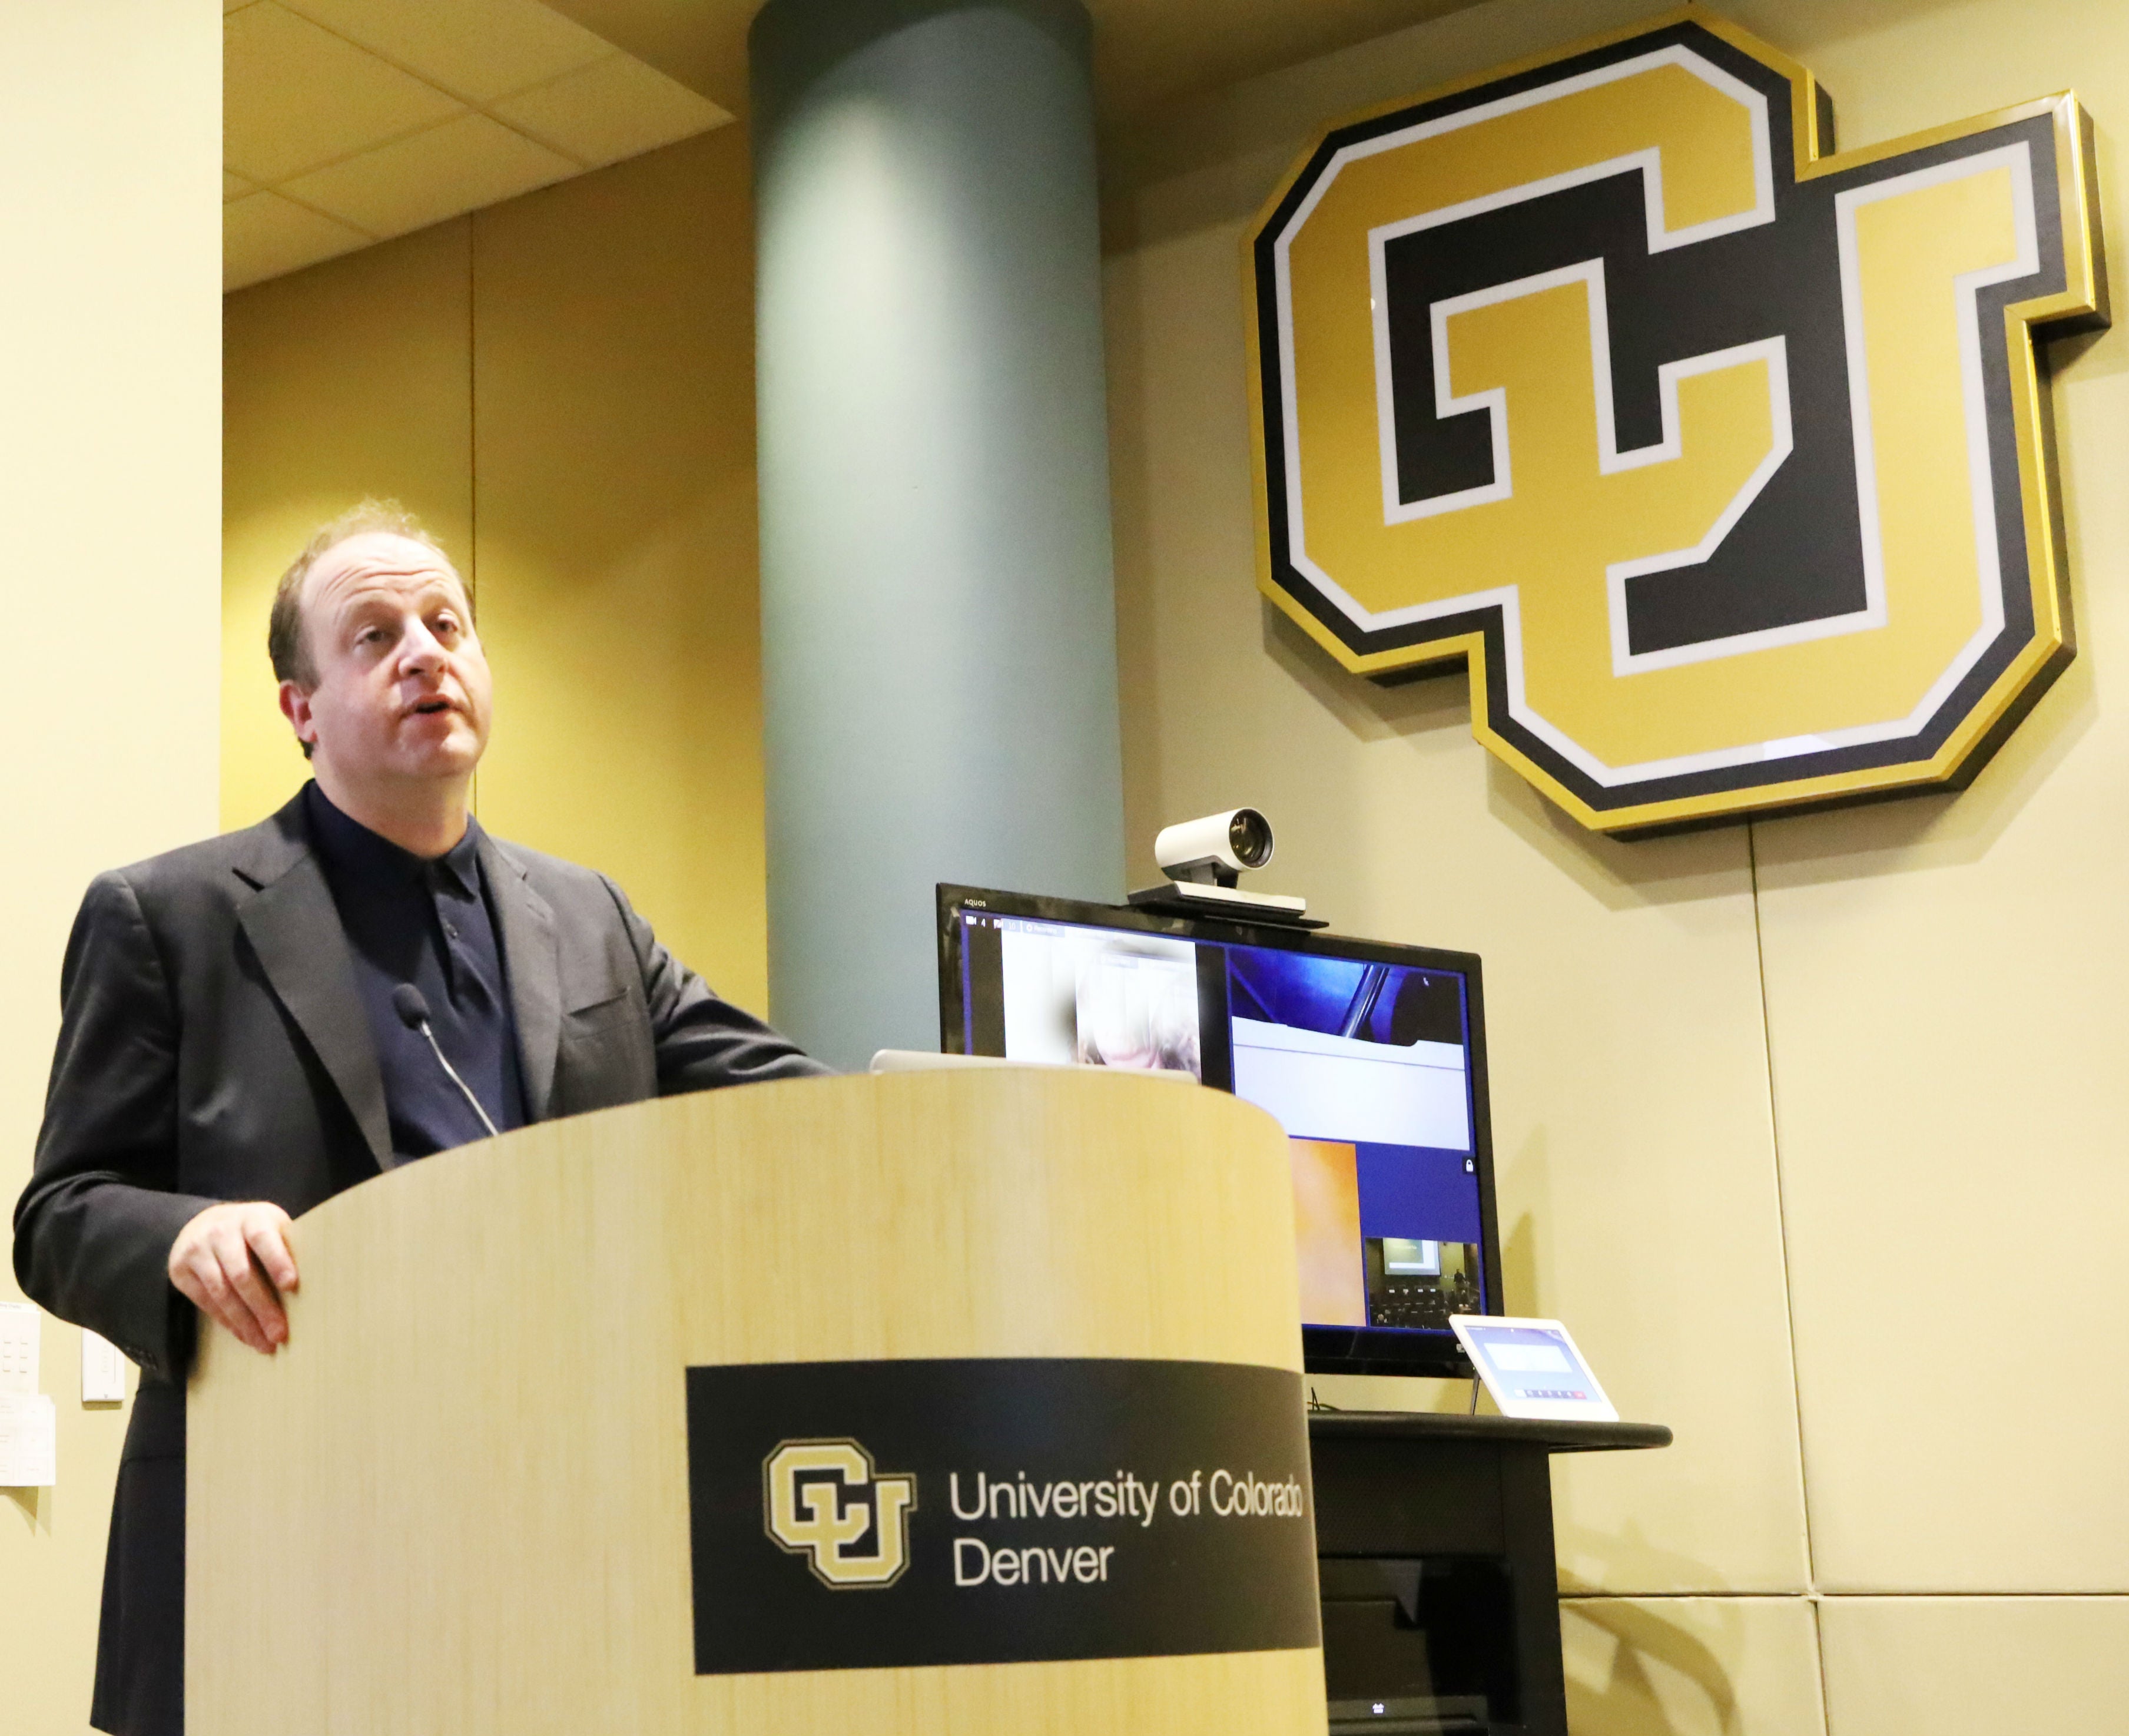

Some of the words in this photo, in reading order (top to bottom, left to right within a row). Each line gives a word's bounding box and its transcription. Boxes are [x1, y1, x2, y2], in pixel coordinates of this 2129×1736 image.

[1251, 19, 2070, 808] CU
[964, 898, 986, 907] AQUOS
[981, 918, 986, 927] 4
[764, 1439, 916, 1588] CU
[950, 1469, 1159, 1528] University
[1169, 1470, 1202, 1516] of
[1209, 1469, 1303, 1518] Colorado
[953, 1537, 1115, 1586] Denver
